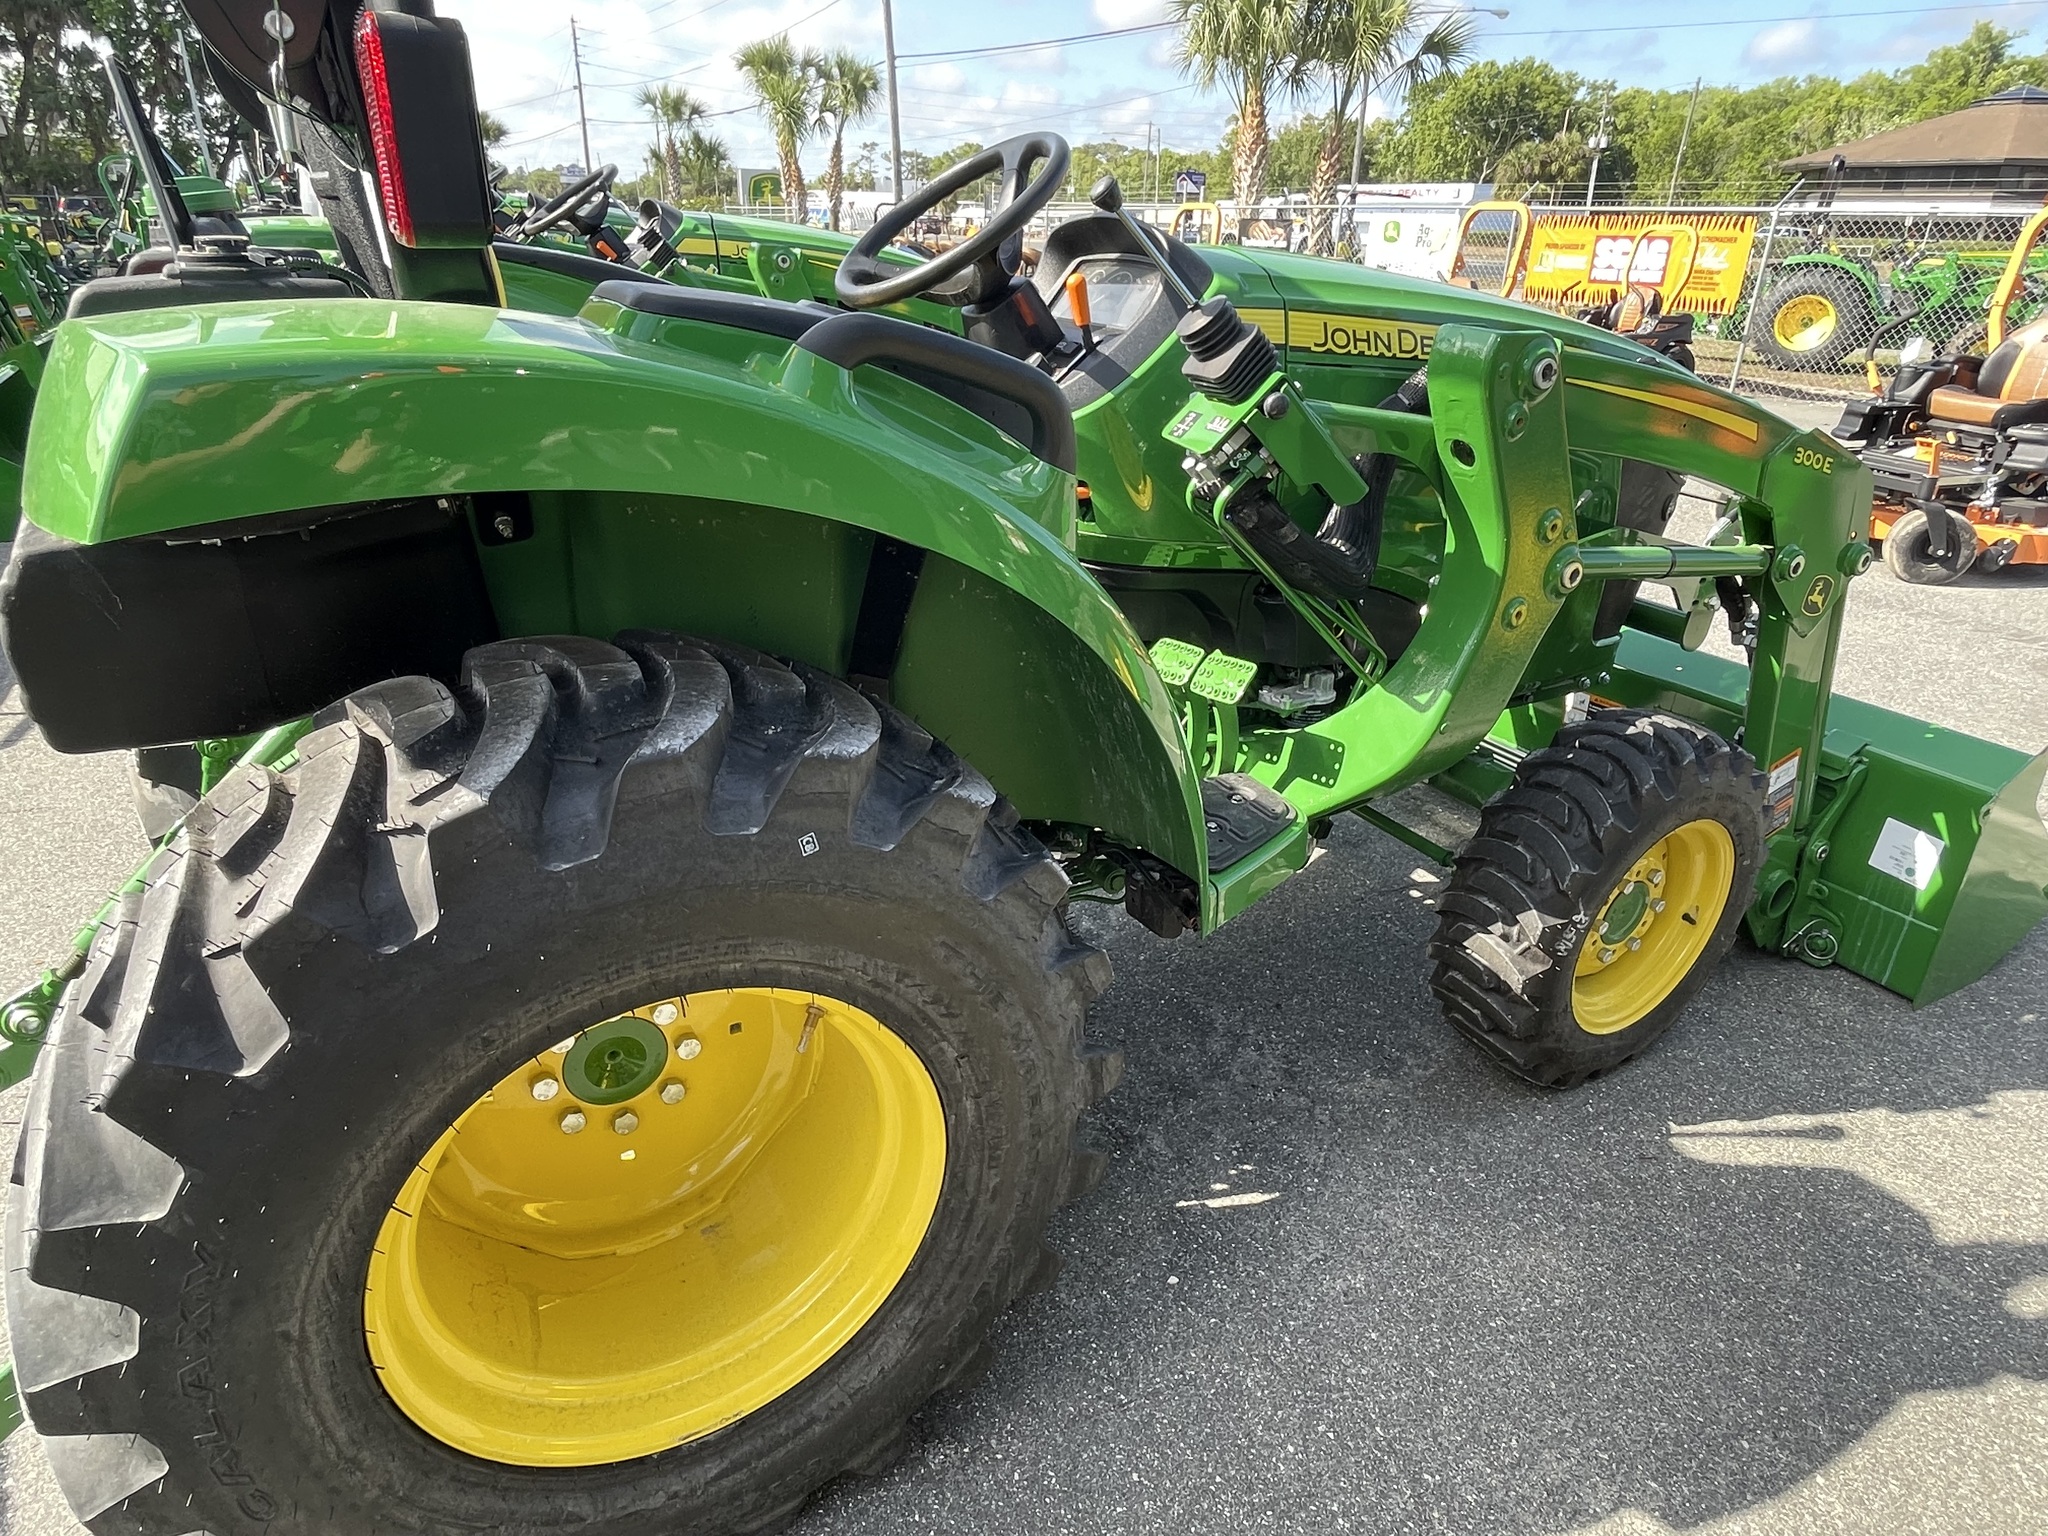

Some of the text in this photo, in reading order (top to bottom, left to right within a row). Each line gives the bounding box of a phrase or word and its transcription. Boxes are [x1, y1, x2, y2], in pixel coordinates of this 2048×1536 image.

[1415, 236, 1432, 248] Pro
[1313, 321, 1434, 356] JOHN DE
[1793, 446, 1834, 474] 300E
[175, 1239, 281, 1523] GALAXY
